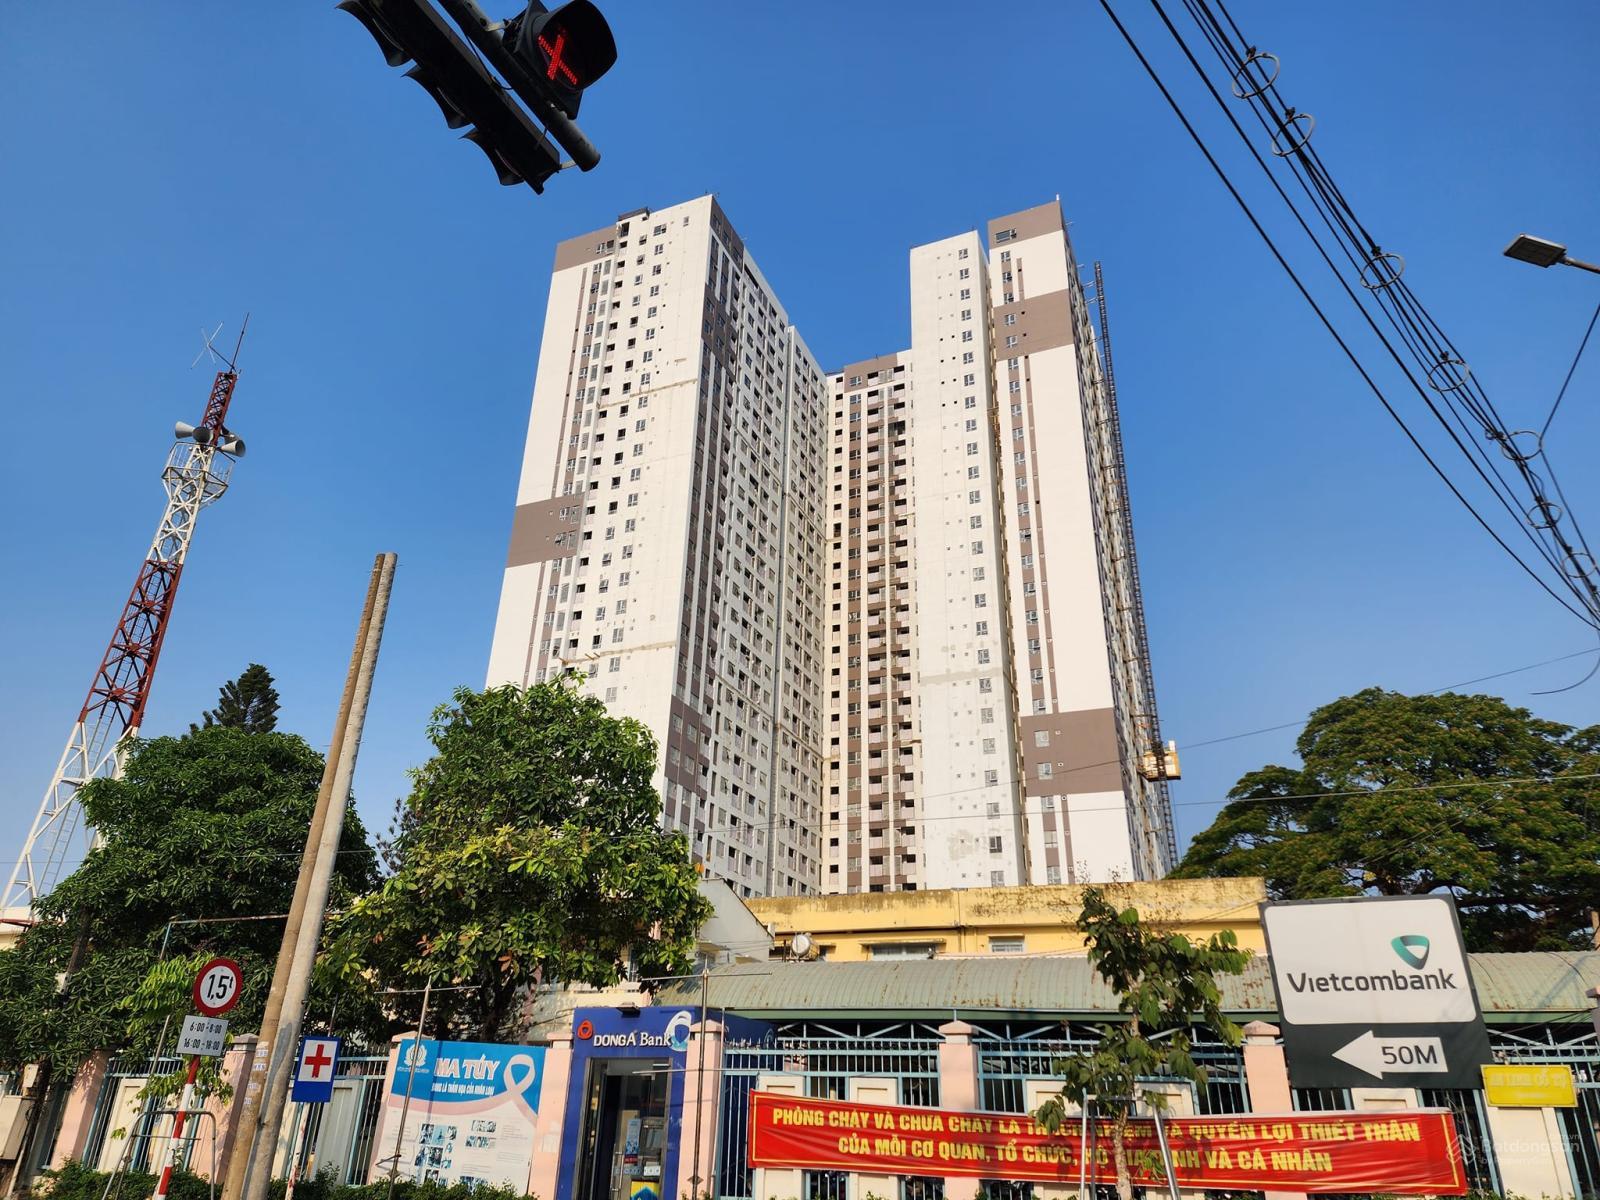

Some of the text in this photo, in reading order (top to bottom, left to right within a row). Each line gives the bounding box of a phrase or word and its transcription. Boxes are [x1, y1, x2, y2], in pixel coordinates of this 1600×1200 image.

[1286, 968, 1457, 993] Vietcombank
[639, 1031, 672, 1047] Bank
[434, 1053, 501, 1081] MA TÚY
[1381, 1045, 1438, 1065] 50M
[773, 1106, 825, 1126] PHÒNG
[874, 1111, 895, 1130] VÀ
[838, 1132, 870, 1155] CỦA
[874, 1134, 907, 1157] MỖI
[911, 1140, 934, 1157] CƠ
[938, 1141, 991, 1163] QUAN,
[994, 1138, 1018, 1162] TỔ
[1204, 1147, 1233, 1169] VÀ
[1237, 1147, 1267, 1170] CÁ
[1270, 1147, 1333, 1172] NHÂN
